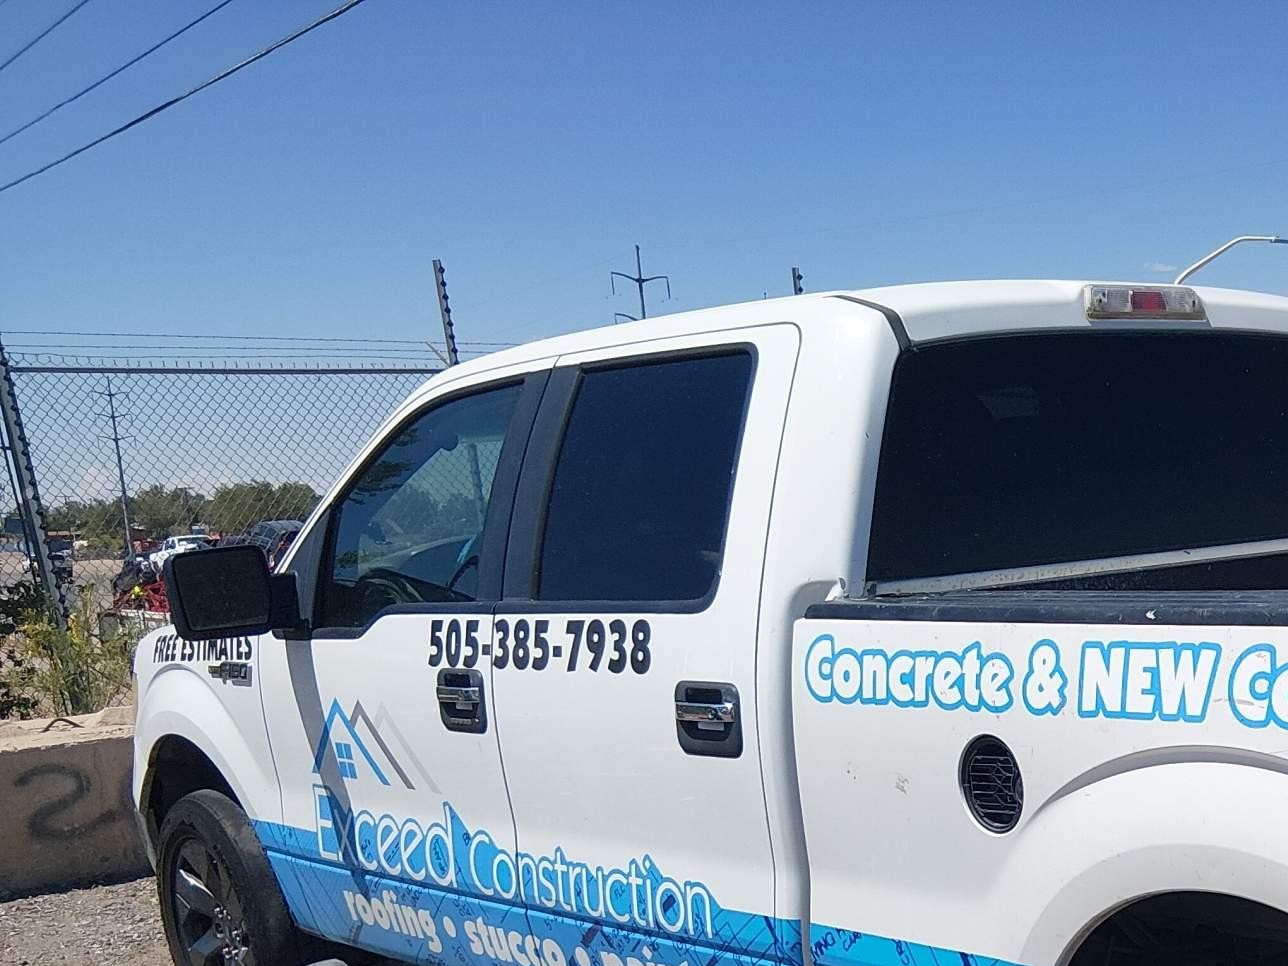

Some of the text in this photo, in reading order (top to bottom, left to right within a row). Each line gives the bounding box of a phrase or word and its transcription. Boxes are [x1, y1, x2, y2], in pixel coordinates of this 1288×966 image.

[153, 634, 252, 663] FREE ESTIMATES
[428, 618, 652, 675] 505-385-7938
[805, 634, 1014, 712] Concrete
[1022, 638, 1067, 716] &
[1077, 640, 1222, 723] NEW
[312, 784, 713, 939] Exceed Construction
[343, 889, 443, 953] roofing
